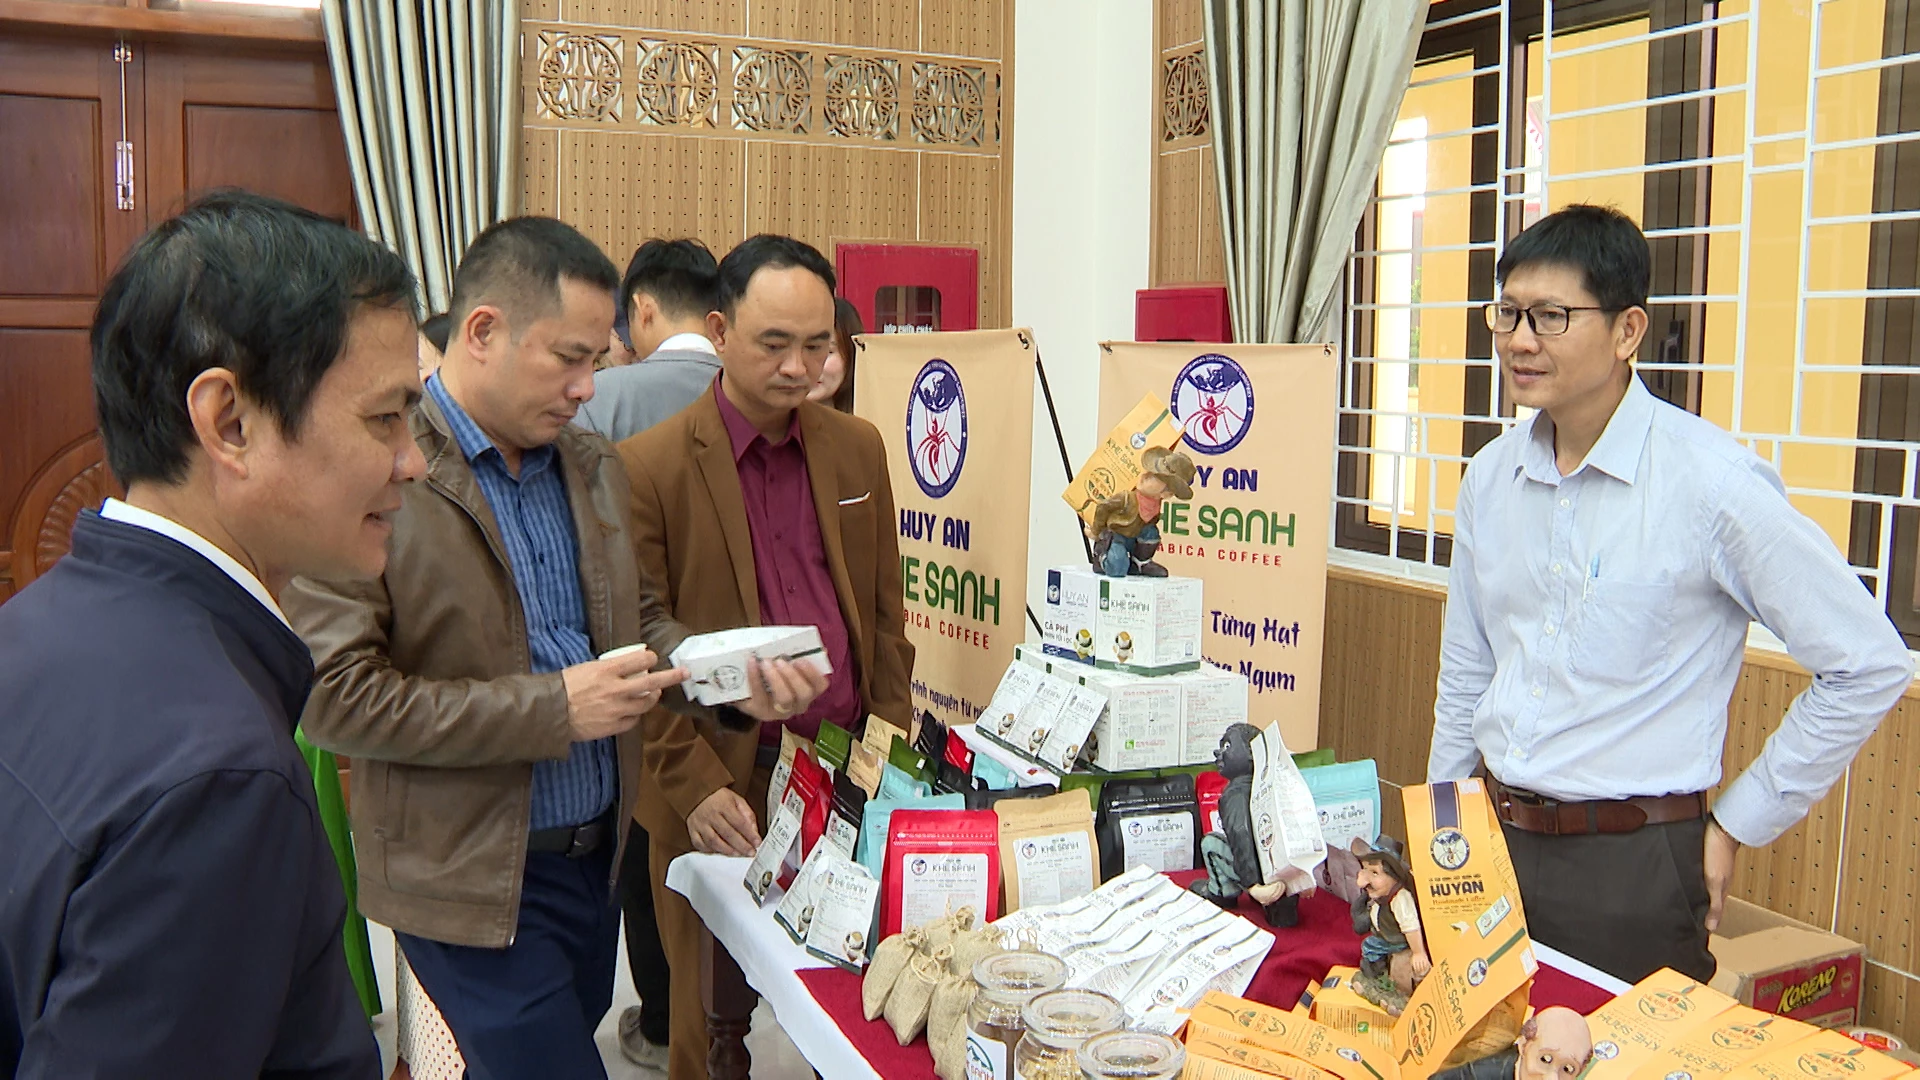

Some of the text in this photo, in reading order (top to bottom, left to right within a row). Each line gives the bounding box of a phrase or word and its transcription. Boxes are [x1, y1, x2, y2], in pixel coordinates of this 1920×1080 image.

[1222, 467, 1258, 492] AN
[900, 508, 970, 552] HUY AN
[1197, 505, 1296, 547] SANH
[1218, 549, 1282, 567] COFFEE
[924, 560, 1000, 626] SANH
[940, 620, 989, 650] COFFEE
[1210, 610, 1256, 647] Từng
[1263, 617, 1300, 648] Hạt
[1430, 880, 1484, 898] HUYAN
[1776, 966, 1838, 1014] KORENO
